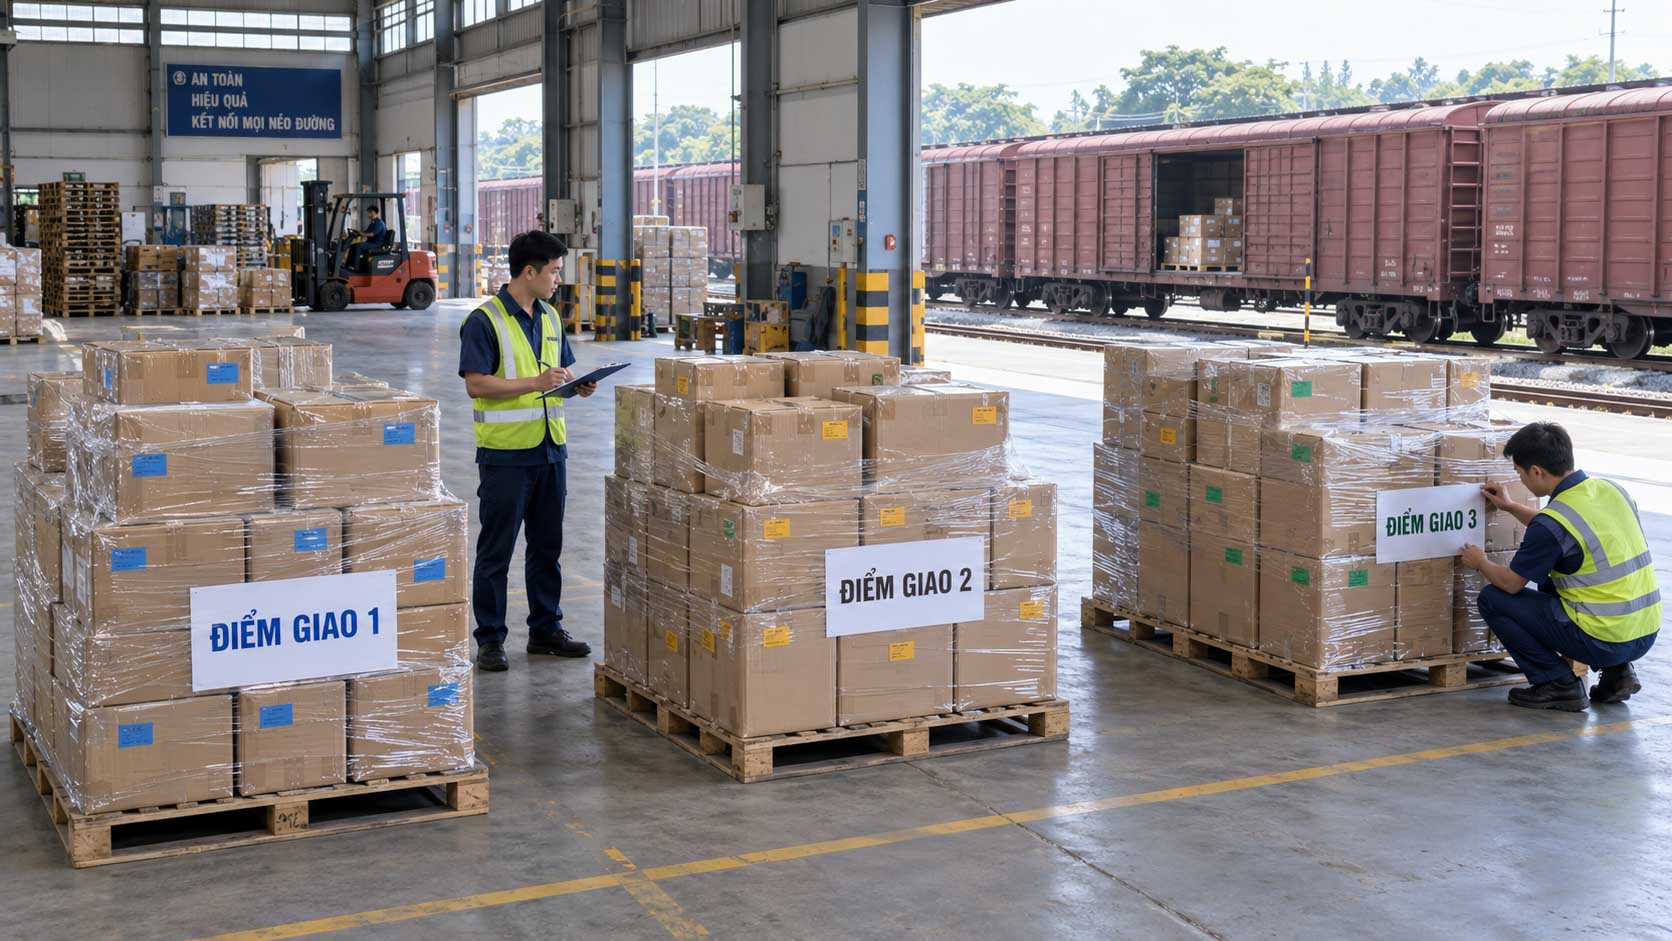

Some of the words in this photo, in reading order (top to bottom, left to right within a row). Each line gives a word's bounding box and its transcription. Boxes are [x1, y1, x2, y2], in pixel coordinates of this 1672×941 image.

[192, 72, 208, 86] AN
[212, 70, 243, 87] TOÀN
[192, 91, 219, 109] HIỆU
[223, 91, 248, 109] QUẢ
[192, 112, 214, 129] KẾT
[218, 112, 239, 129] NỐI
[243, 116, 264, 133] MỌI
[295, 114, 335, 131] ĐƯỜNG
[1386, 508, 1424, 537] ĐIỂM
[1429, 510, 1464, 533] GIAO
[1468, 509, 1477, 529] 3
[840, 567, 894, 604] ĐIỂM
[903, 569, 952, 597] GIAO
[960, 567, 972, 592] 2
[210, 609, 282, 652] ĐIỂM
[293, 609, 358, 644] GIAO
[368, 607, 380, 635] 1
